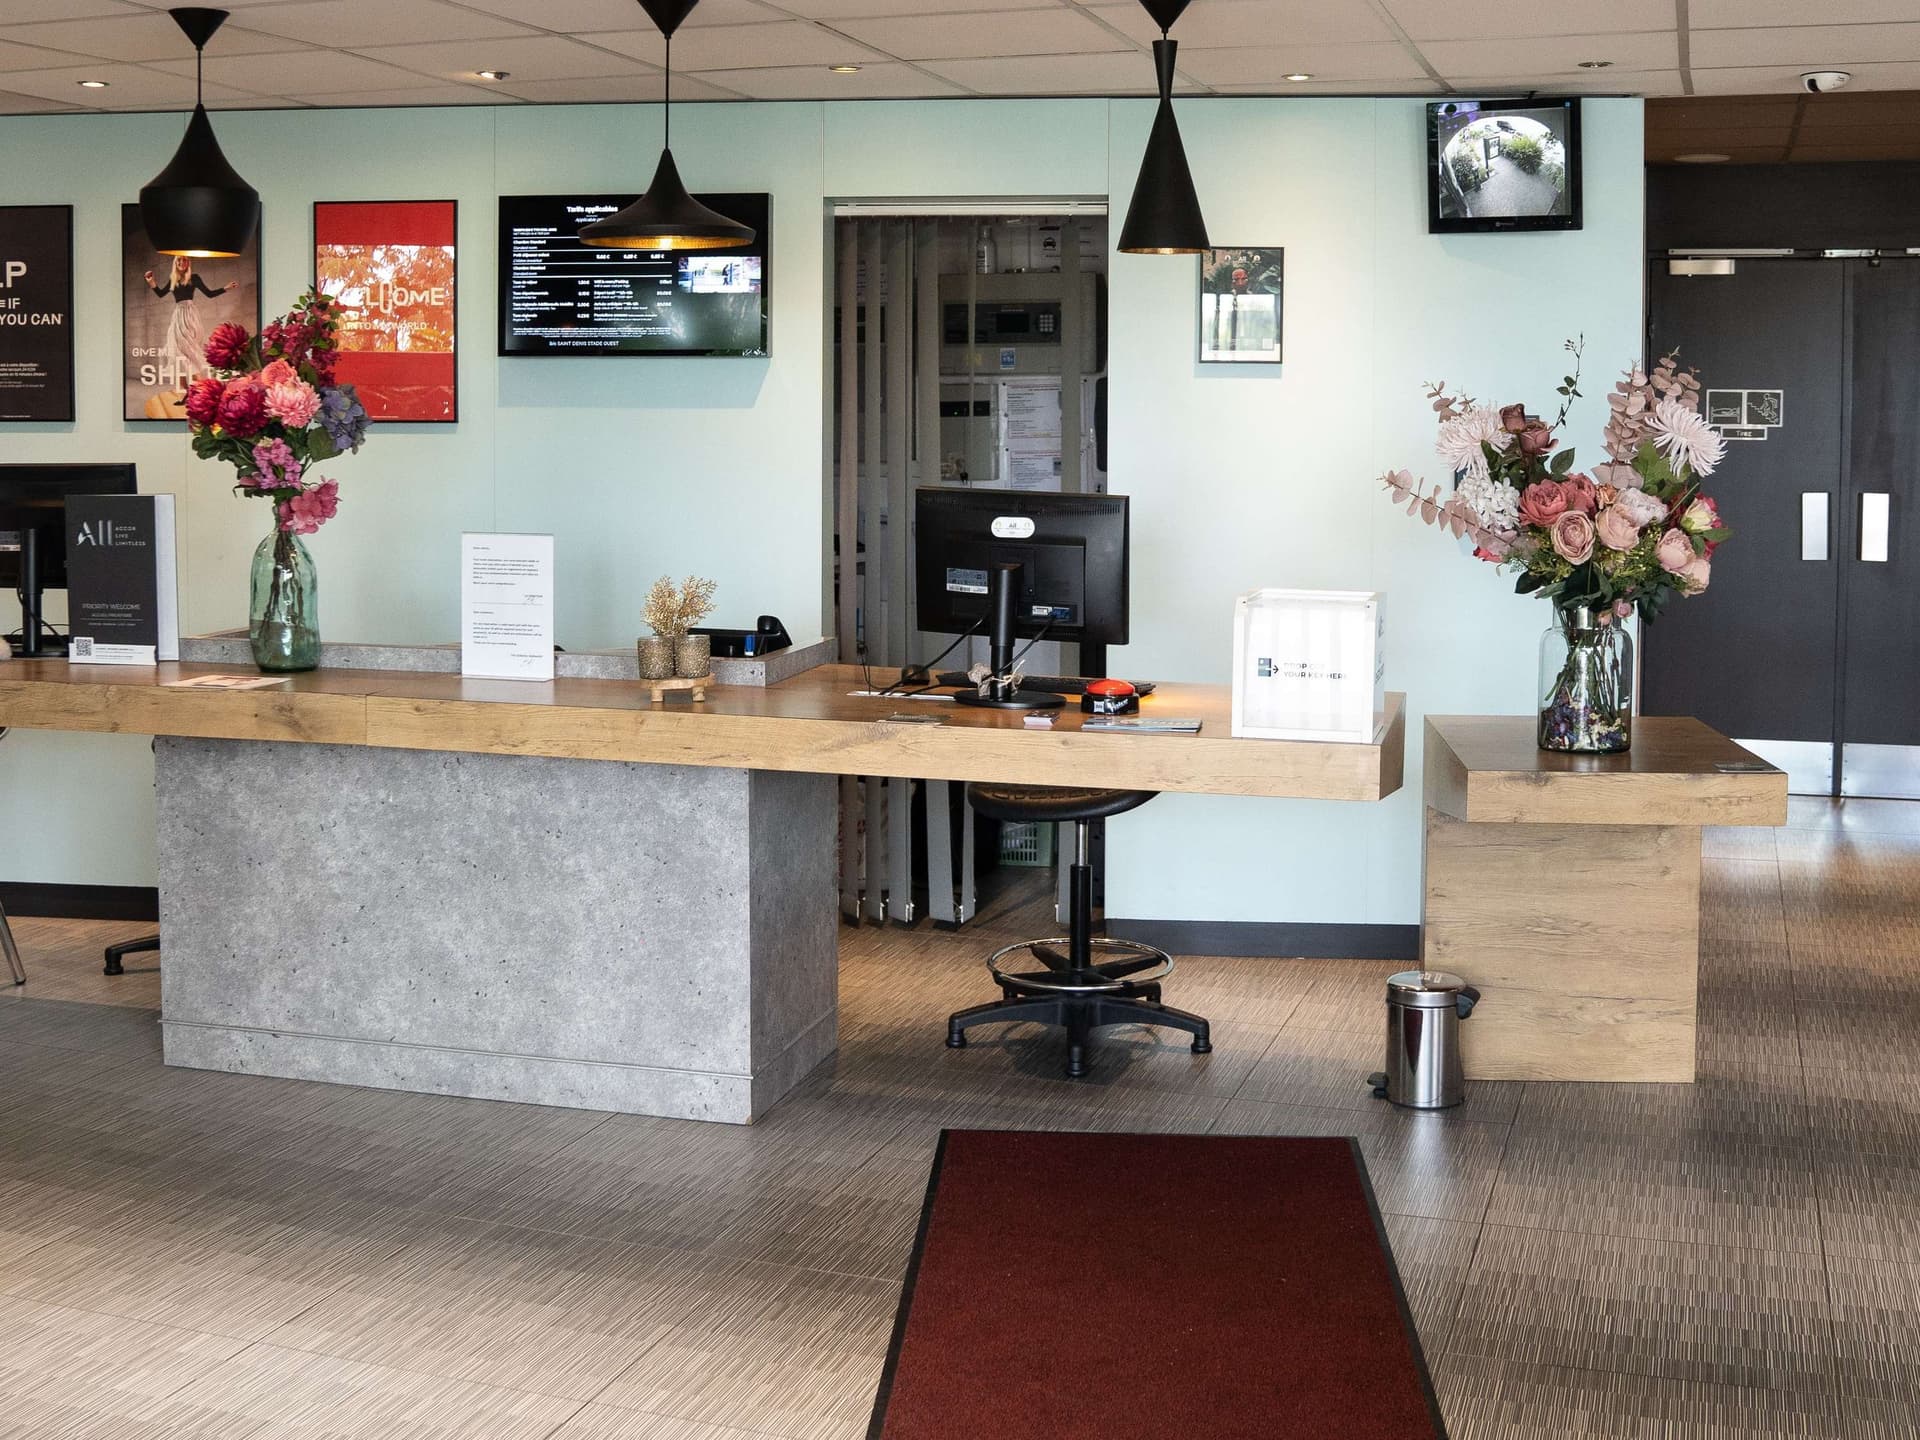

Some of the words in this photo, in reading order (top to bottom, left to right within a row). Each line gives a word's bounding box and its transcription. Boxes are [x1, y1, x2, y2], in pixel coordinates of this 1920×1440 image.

[8, 297, 20, 309] IF
[0, 313, 27, 325] YOU
[132, 347, 156, 357] GIVE
